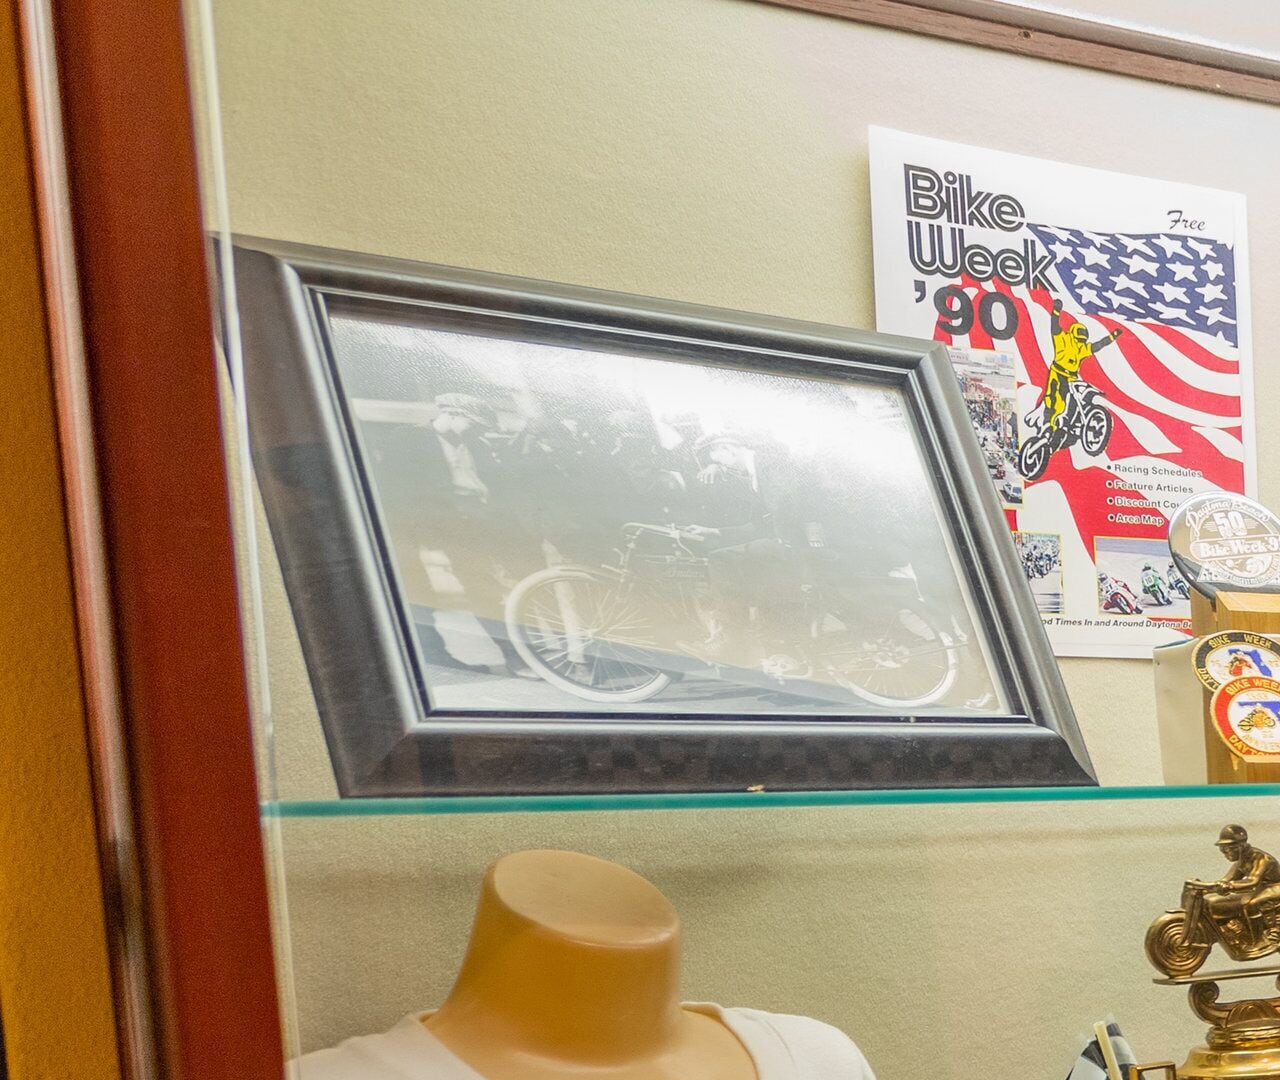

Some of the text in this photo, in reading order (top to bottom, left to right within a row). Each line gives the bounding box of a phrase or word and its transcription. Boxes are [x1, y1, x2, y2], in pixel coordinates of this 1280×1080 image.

[903, 163, 1026, 231] Bike
[1167, 210, 1206, 232] Free
[906, 221, 1059, 292] Week
[915, 282, 1019, 340] '90
[1114, 464, 1202, 478] Racing Schedules
[1114, 481, 1194, 494] Feature Articles
[1116, 497, 1161, 509] Discount
[1117, 514, 1164, 526] Area Map
[1213, 511, 1248, 537] 50
[1199, 542, 1230, 558] Bike
[1230, 539, 1266, 555] Week
[1055, 618, 1082, 627] Times
[1084, 619, 1093, 627] In
[1094, 619, 1110, 627] and
[1112, 619, 1144, 627] Around
[1146, 620, 1181, 629] Daytona
[1208, 634, 1272, 649] BIKE WEEK
[1225, 678, 1251, 696] BIKE
